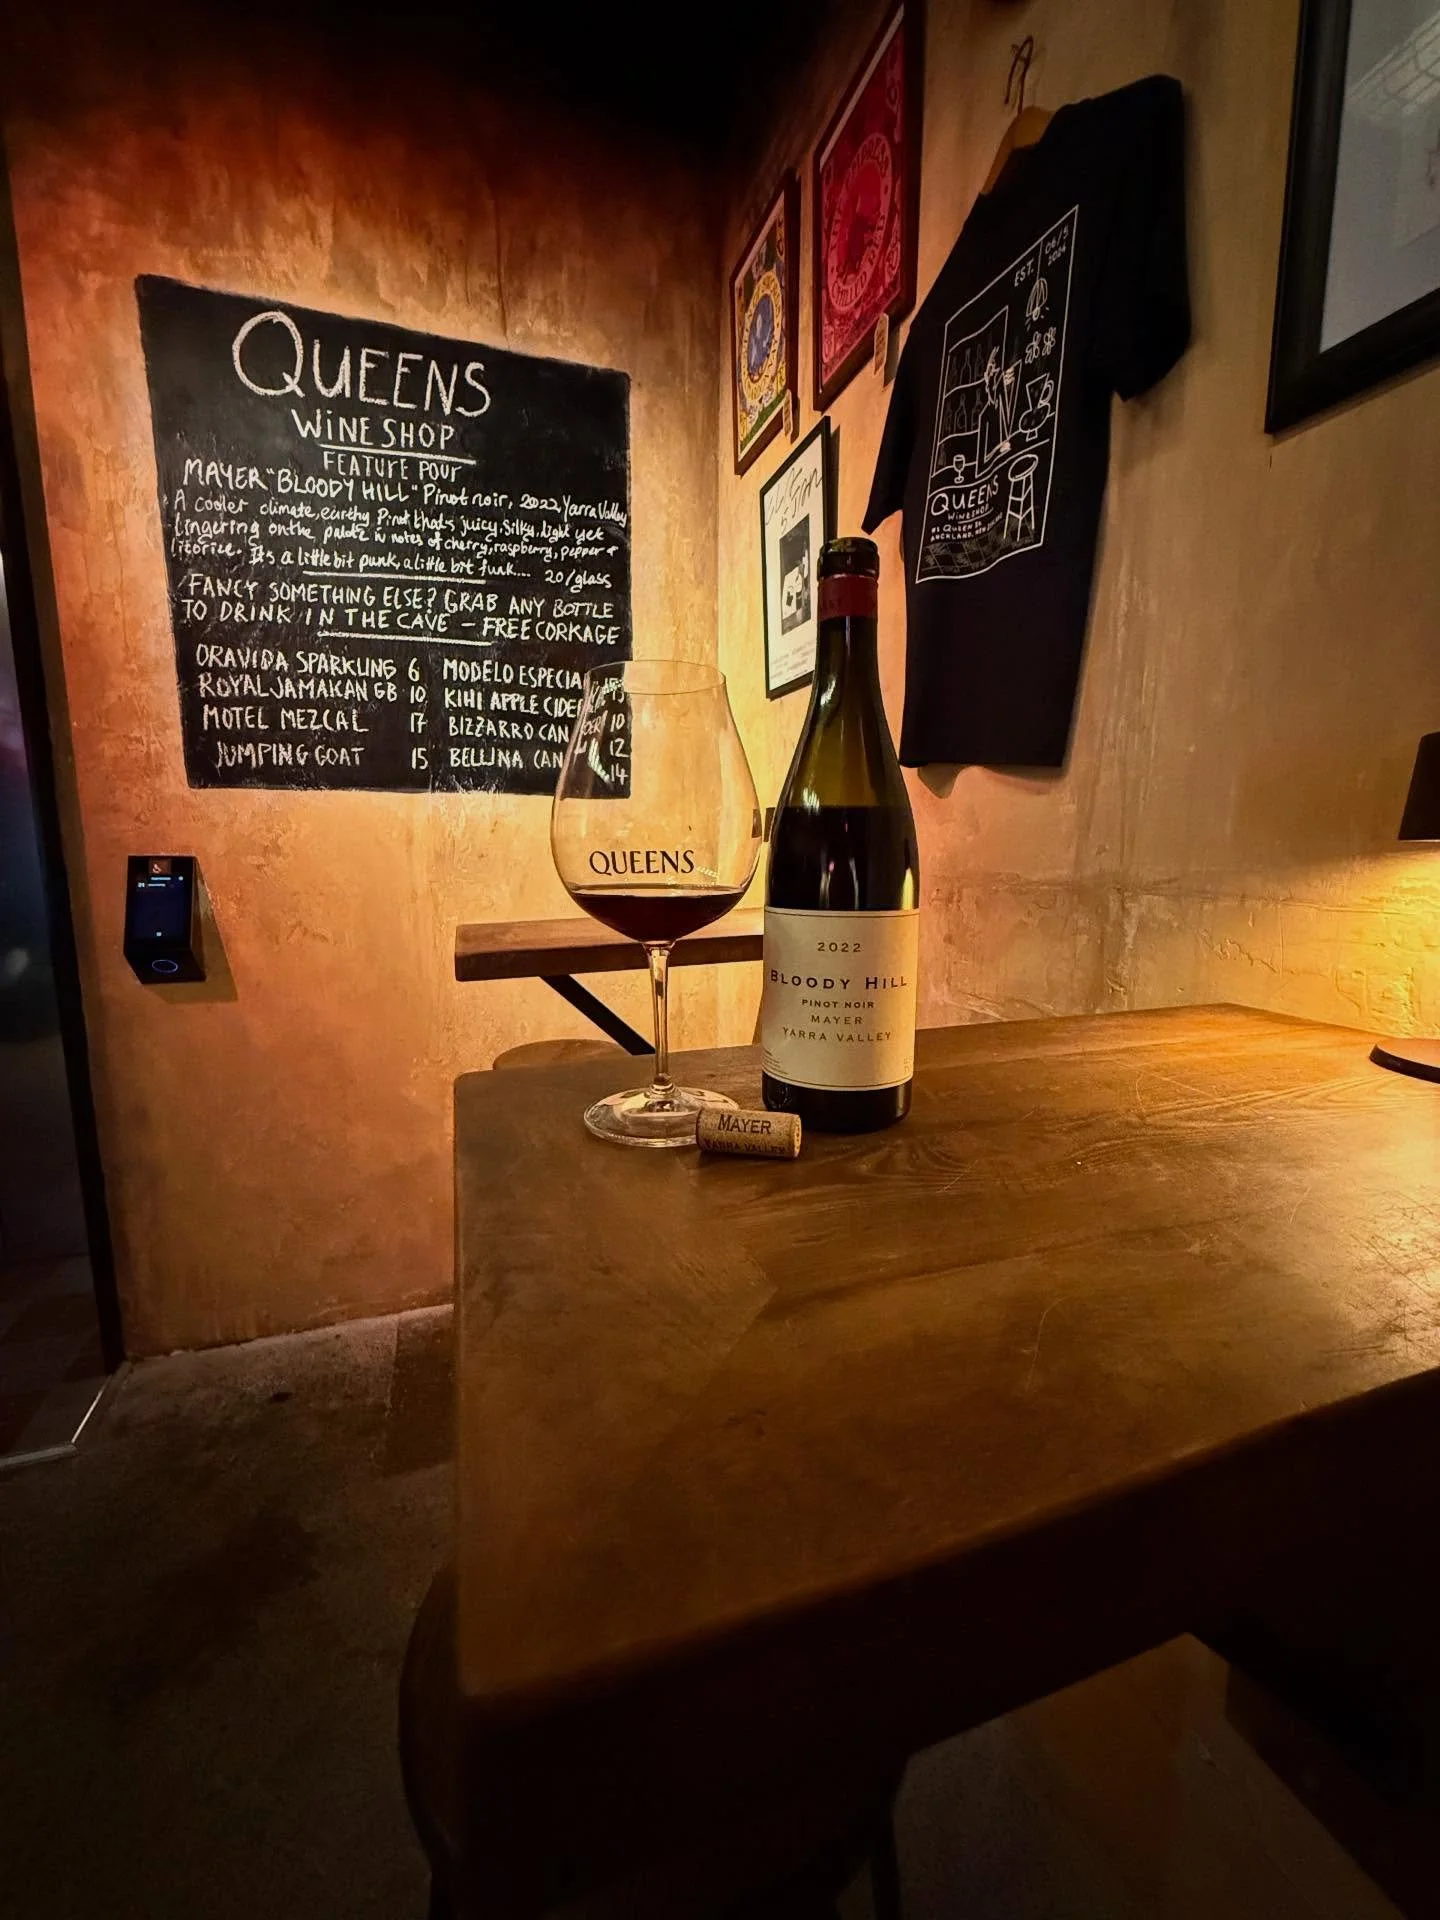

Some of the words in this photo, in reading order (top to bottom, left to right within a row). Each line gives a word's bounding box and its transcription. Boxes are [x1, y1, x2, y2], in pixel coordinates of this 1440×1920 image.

[1014, 258, 1034, 287] EST.
[231, 310, 491, 418] QUEENS
[382, 418, 455, 450] SHOP
[183, 457, 269, 491] MAYER
[422, 483, 468, 507] Pinot
[472, 492, 513, 510] noir,
[563, 495, 598, 523] Yarra
[597, 500, 628, 528] Valley
[931, 474, 999, 516] QUEENS
[174, 488, 186, 512] A
[321, 505, 371, 528] earthy
[376, 507, 411, 526] Pinot
[574, 526, 605, 546] yet
[943, 523, 973, 533] QUEEN
[281, 551, 294, 566] a
[298, 547, 333, 568] little
[333, 549, 354, 569] bit
[359, 553, 402, 573] punk,
[403, 557, 413, 570] a
[413, 552, 448, 574] little
[450, 558, 475, 576] bit
[391, 529, 423, 548] notes
[427, 531, 443, 551] of
[444, 537, 494, 560] cherry,
[493, 541, 559, 563] raspberry,
[560, 545, 604, 563] pepper
[188, 573, 259, 599] FANCY
[269, 581, 377, 606] SOMETHING
[383, 585, 438, 614] ELSE?
[444, 588, 499, 614] GRAB
[508, 595, 546, 618] ANY
[553, 599, 614, 620] BOTTLE
[182, 598, 208, 622] TO
[219, 601, 292, 625] DRINK
[305, 607, 336, 627] IN
[345, 608, 390, 630] THE
[396, 611, 451, 633] CAVE
[482, 616, 532, 641] FREE
[535, 620, 621, 646] CORKAGE
[196, 642, 290, 673] ORAVIDA
[296, 650, 398, 680] SPARKLING
[407, 657, 421, 683] 6
[442, 658, 515, 685] MODELO
[519, 664, 583, 691] ESPECIA
[199, 671, 269, 698] ROYAL
[373, 681, 398, 703] GB
[410, 685, 428, 704] 10
[203, 704, 270, 732] MOTEL
[280, 707, 370, 732] MEZCAL
[410, 712, 429, 734] 17
[444, 687, 483, 711] KIHI
[490, 689, 540, 715] APPLE
[609, 713, 626, 733] 10
[448, 716, 534, 741] BIZZARRO
[538, 724, 570, 744] CAN
[609, 737, 630, 759] 12
[214, 741, 309, 771] JUMPING
[314, 744, 366, 767] GOAT
[411, 747, 429, 771] 15
[449, 747, 525, 770] BELLINA
[533, 749, 564, 770] CAN
[609, 763, 630, 786] 14
[589, 849, 696, 877] QUEENS
[816, 941, 862, 953] 2022
[770, 969, 851, 991] BLOODY
[865, 975, 908, 991] HILL
[801, 999, 838, 1009] PINOT
[844, 1001, 875, 1009] NOIR
[810, 1014, 863, 1025] MAYER
[782, 1026, 828, 1041] YARRA
[836, 1031, 892, 1042] VALLEY
[717, 1113, 772, 1135] MAYER
